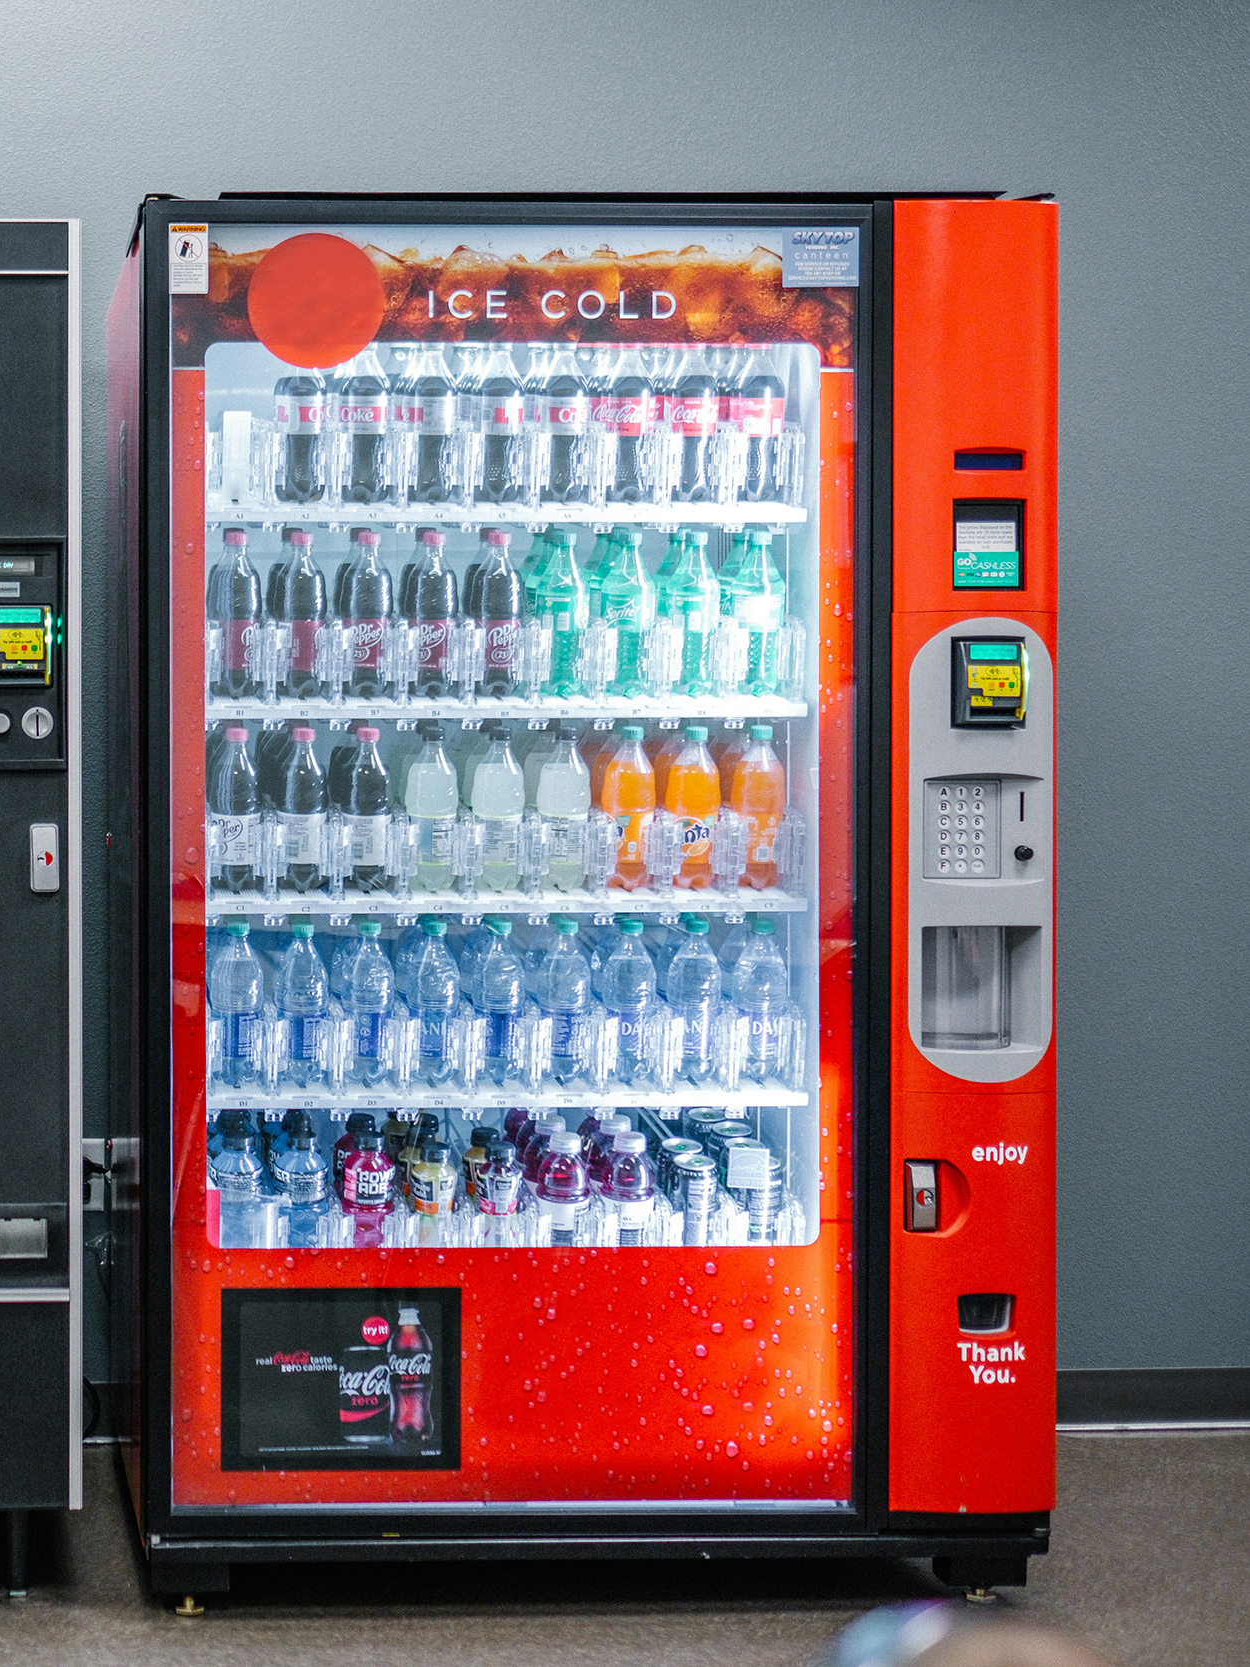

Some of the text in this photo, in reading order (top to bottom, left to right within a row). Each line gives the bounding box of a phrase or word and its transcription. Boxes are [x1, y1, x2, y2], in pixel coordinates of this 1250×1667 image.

[794, 252, 849, 260] canteen
[428, 290, 677, 320] ICE COLD
[605, 608, 637, 624] Sprite
[958, 847, 963, 855] 9
[972, 1142, 1028, 1164] enjoy
[363, 1325, 388, 1336] try it!
[957, 1342, 1026, 1362] Thank
[256, 1356, 273, 1365] real
[310, 1355, 332, 1364] taste
[281, 1363, 338, 1372] zero calories
[969, 1365, 1016, 1384] You.
[352, 1396, 378, 1406] zero
